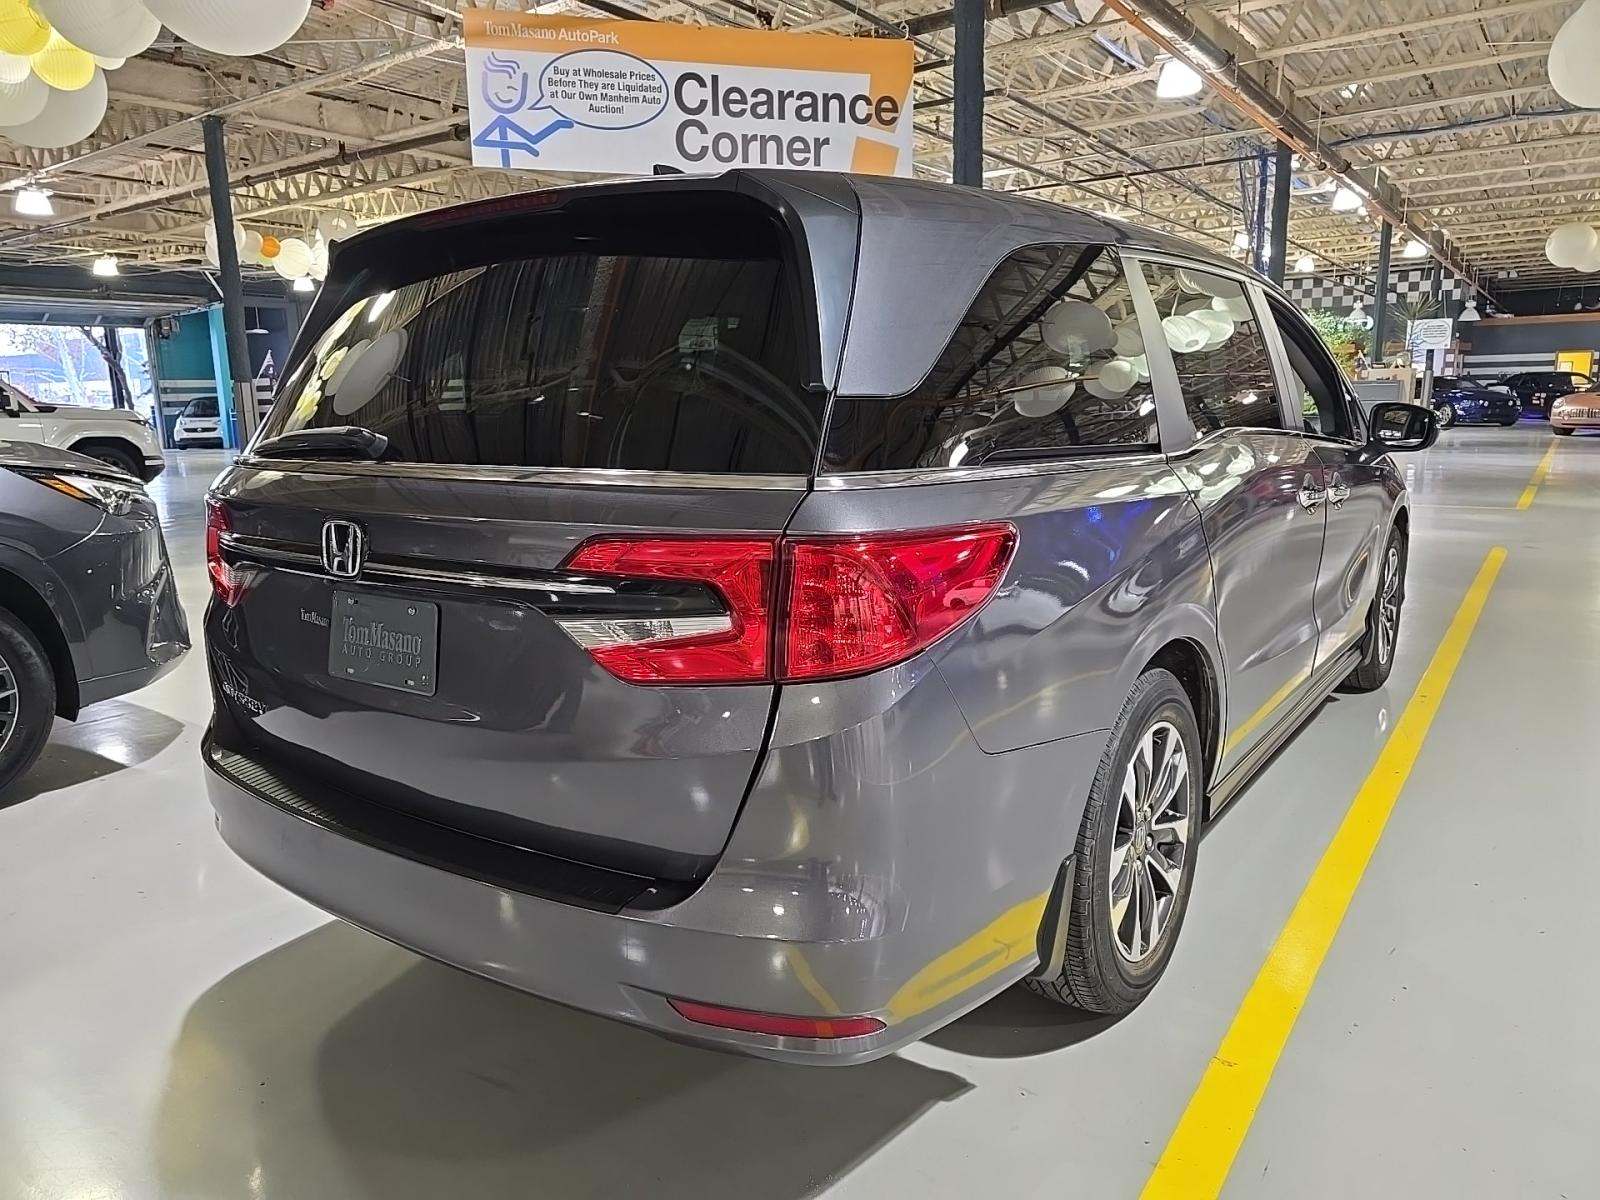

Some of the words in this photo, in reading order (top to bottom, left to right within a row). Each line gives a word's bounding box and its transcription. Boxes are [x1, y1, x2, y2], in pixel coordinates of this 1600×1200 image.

[558, 27, 620, 45] AutoPark
[553, 66, 570, 77] Buy
[572, 67, 582, 77] at
[583, 67, 627, 80] Wholesale
[629, 70, 656, 81] Prices
[547, 77, 576, 88] Before
[578, 79, 599, 91] They
[601, 82, 616, 91] are
[618, 83, 662, 94] Liquidated
[549, 90, 559, 99] at
[561, 90, 576, 100] Our
[579, 91, 598, 101] Own
[600, 92, 640, 104] Manheim
[641, 95, 661, 105] Auto
[674, 72, 899, 126] Clearance
[588, 103, 624, 115] Auction!
[675, 119, 831, 167] Corner
[342, 642, 371, 660] AUTO
[379, 651, 421, 668] GROUP
